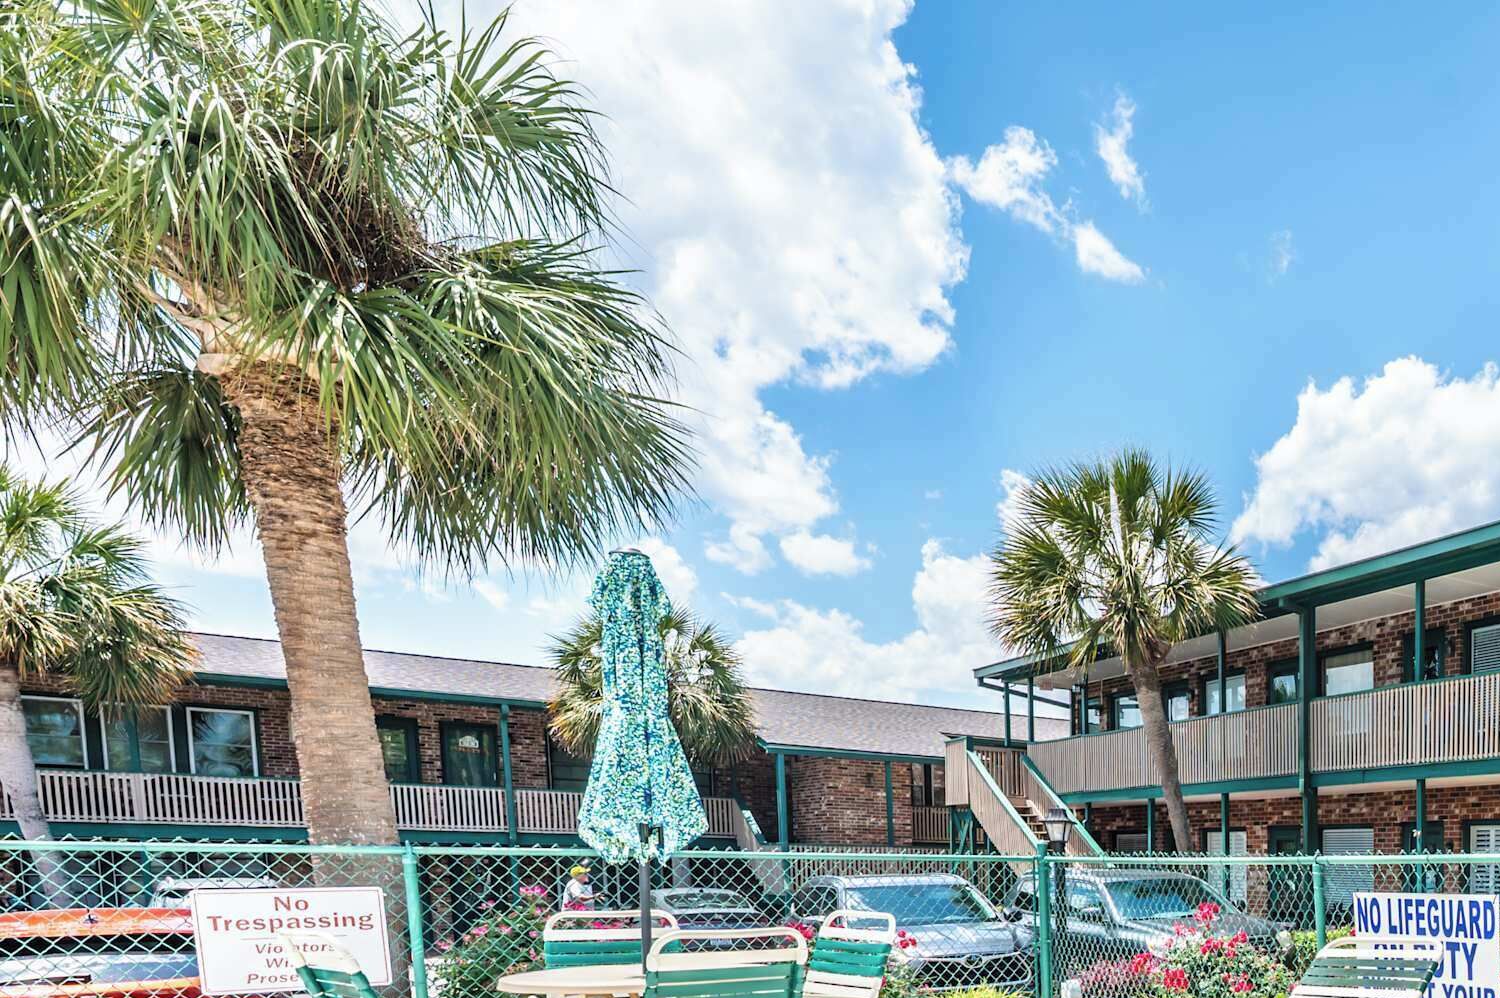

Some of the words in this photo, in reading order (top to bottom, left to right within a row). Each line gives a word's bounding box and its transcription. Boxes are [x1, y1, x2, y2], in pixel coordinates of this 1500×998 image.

[274, 896, 309, 911] No
[207, 912, 374, 933] Trespassing
[1357, 897, 1381, 933] NO
[1387, 898, 1495, 940] LIFEGUARD
